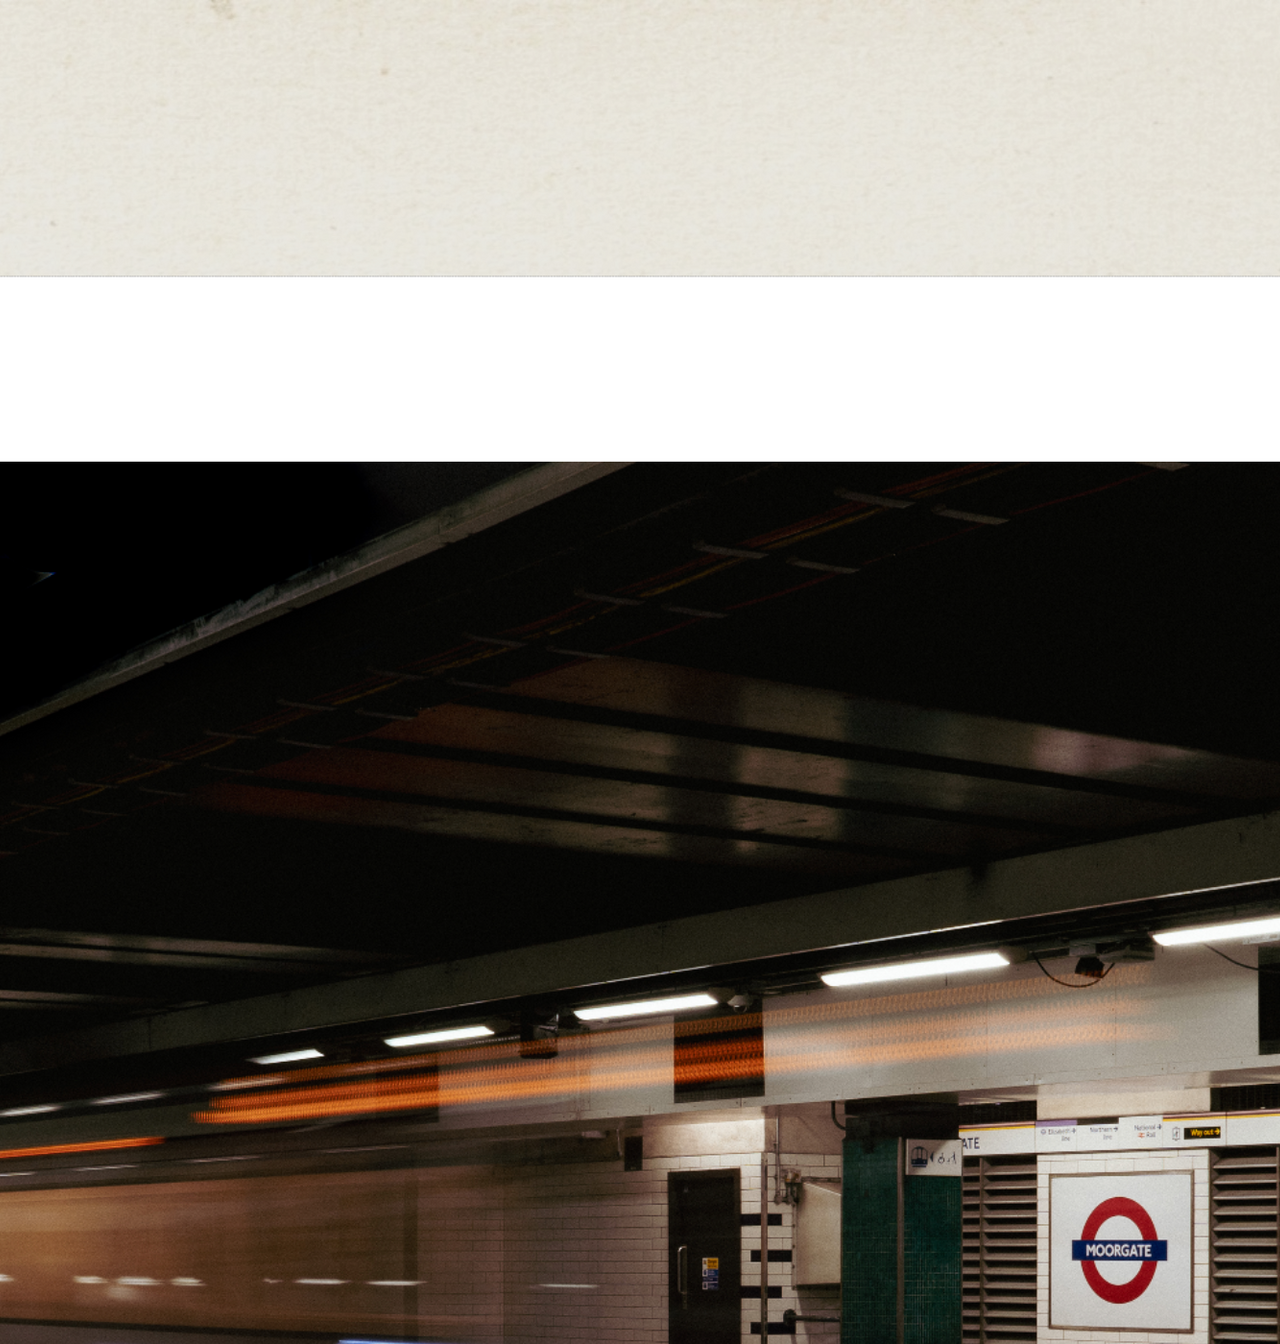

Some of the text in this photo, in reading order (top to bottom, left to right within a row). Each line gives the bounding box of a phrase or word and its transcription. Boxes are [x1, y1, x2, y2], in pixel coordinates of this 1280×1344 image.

[1190, 1128, 1214, 1138] Way out
[1085, 1243, 1152, 1258] MOORGATE
